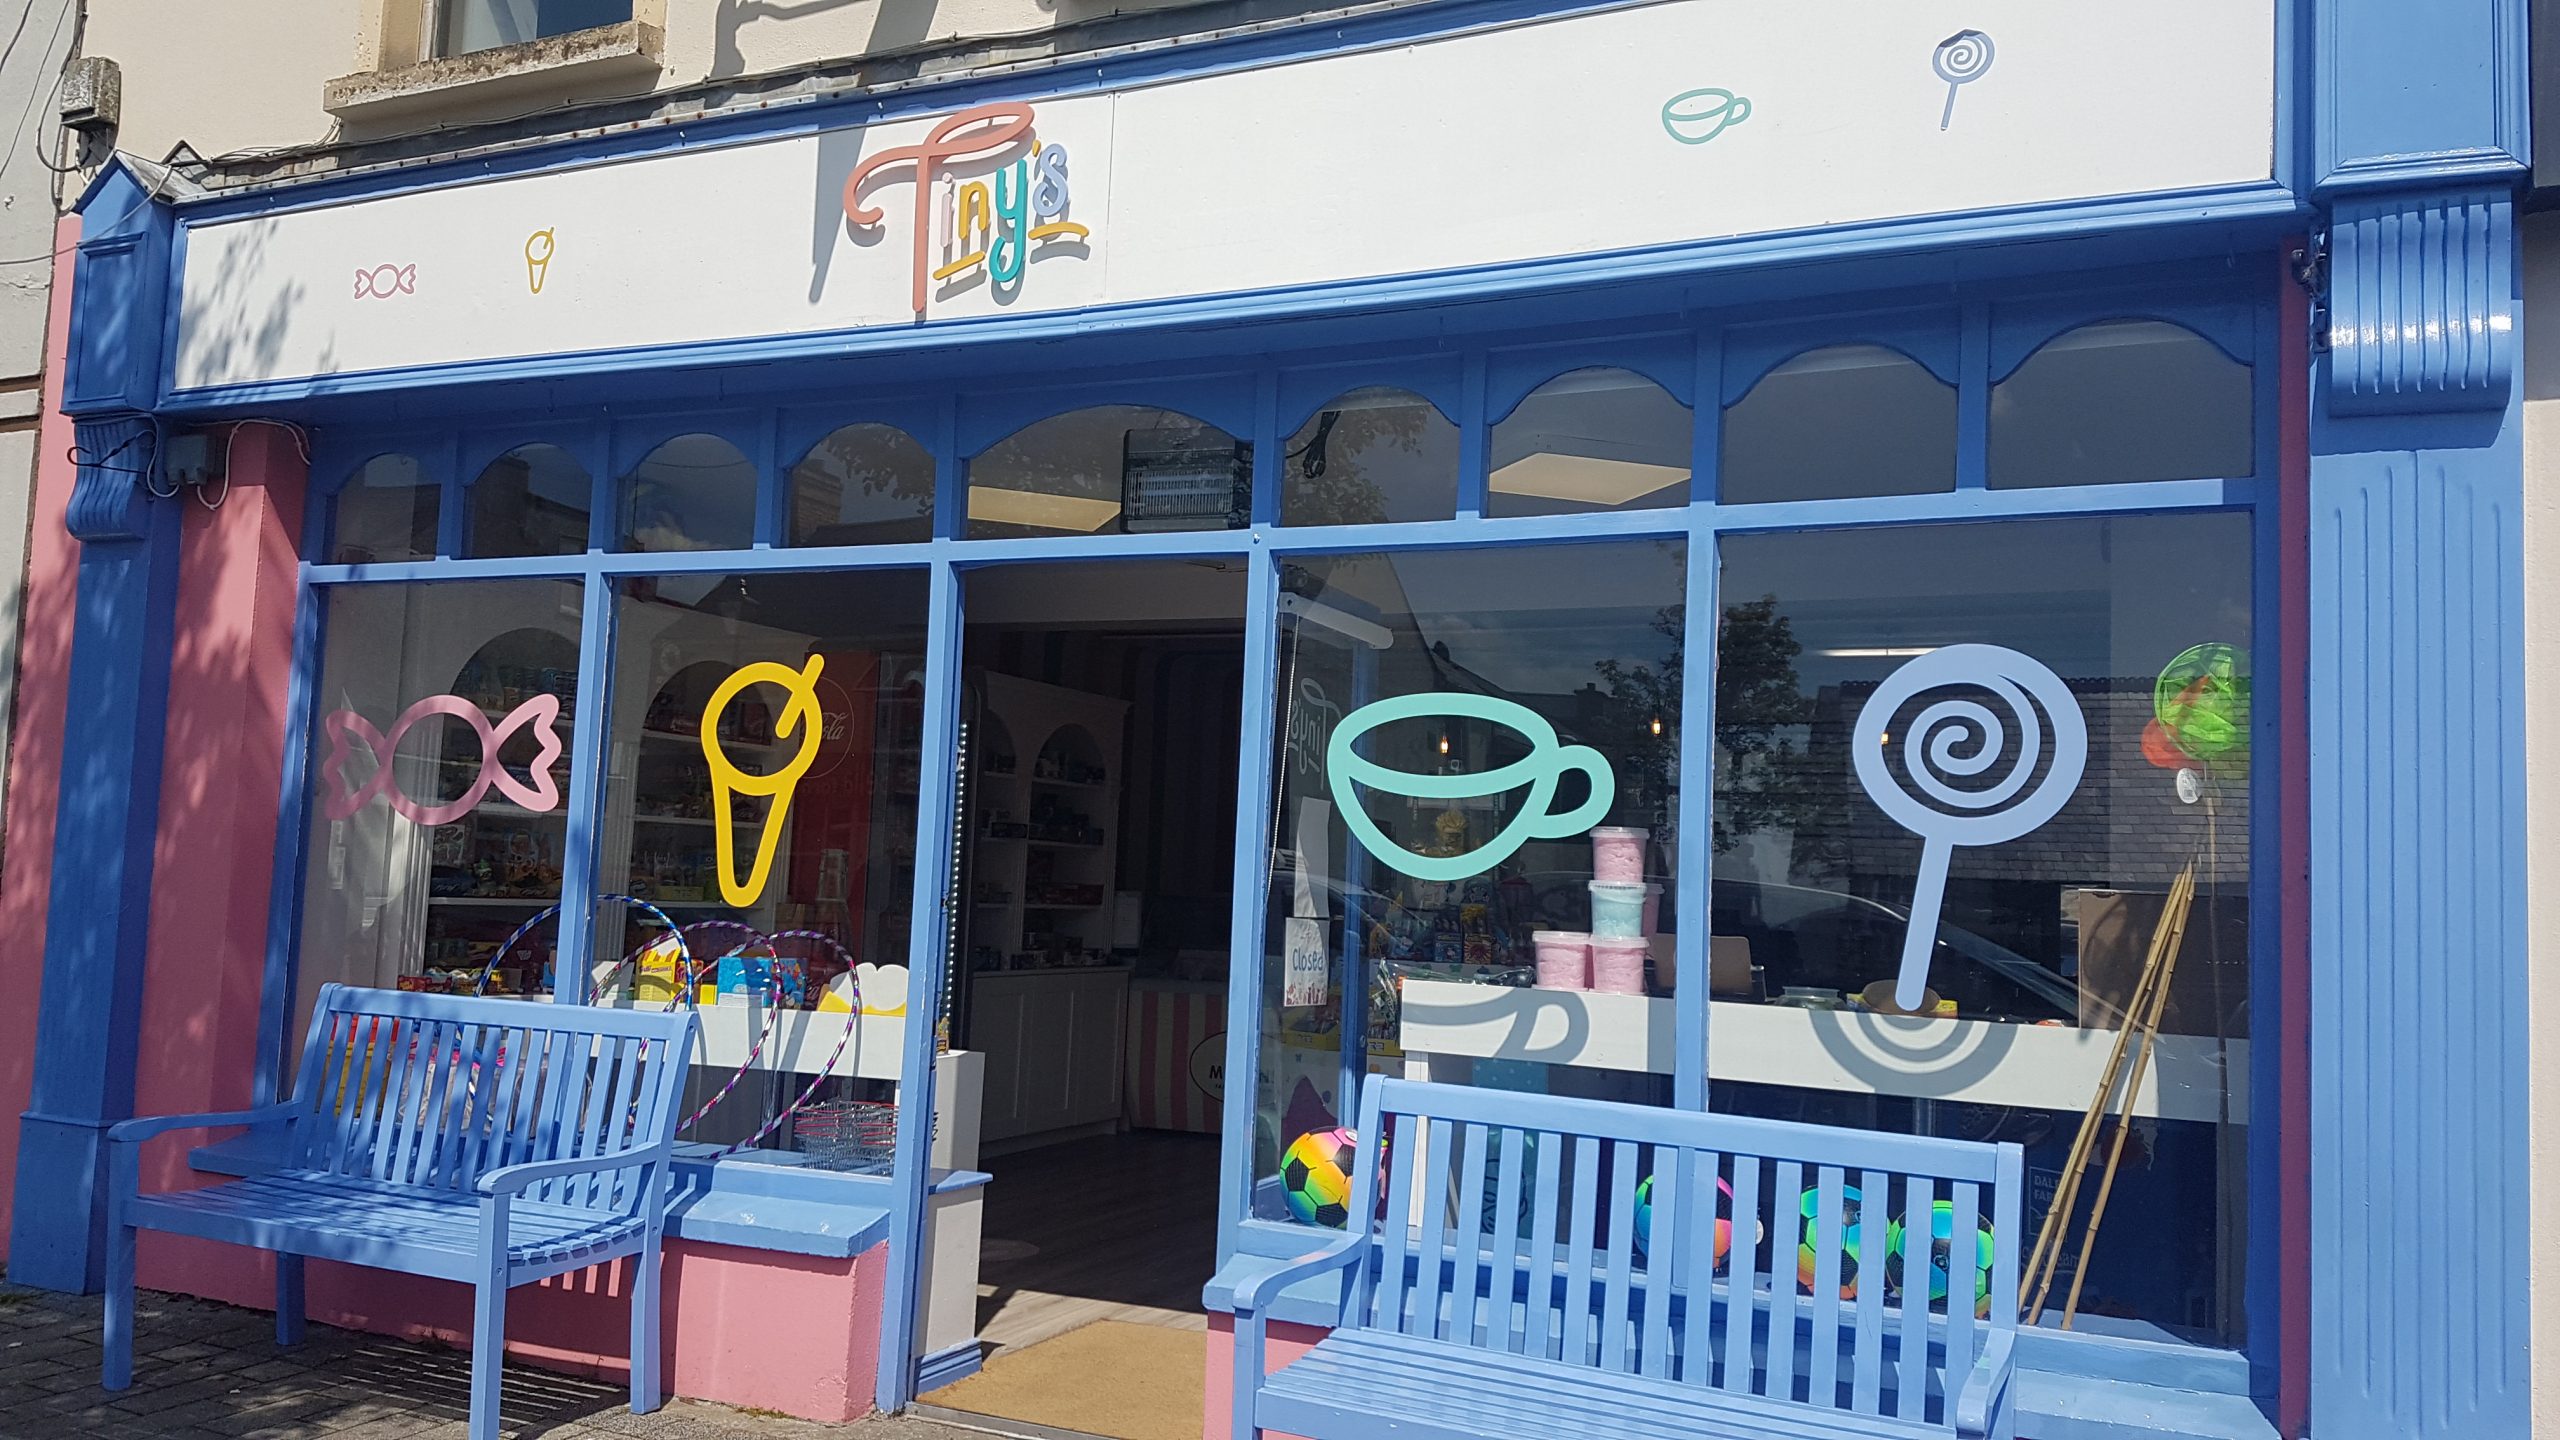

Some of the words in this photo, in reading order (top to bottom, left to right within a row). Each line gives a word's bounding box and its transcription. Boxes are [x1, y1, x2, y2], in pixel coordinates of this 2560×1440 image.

[843, 101, 1088, 312] Tiny's
[1292, 946, 1324, 972] Closed
[2034, 1189, 2053, 1202] FAR
